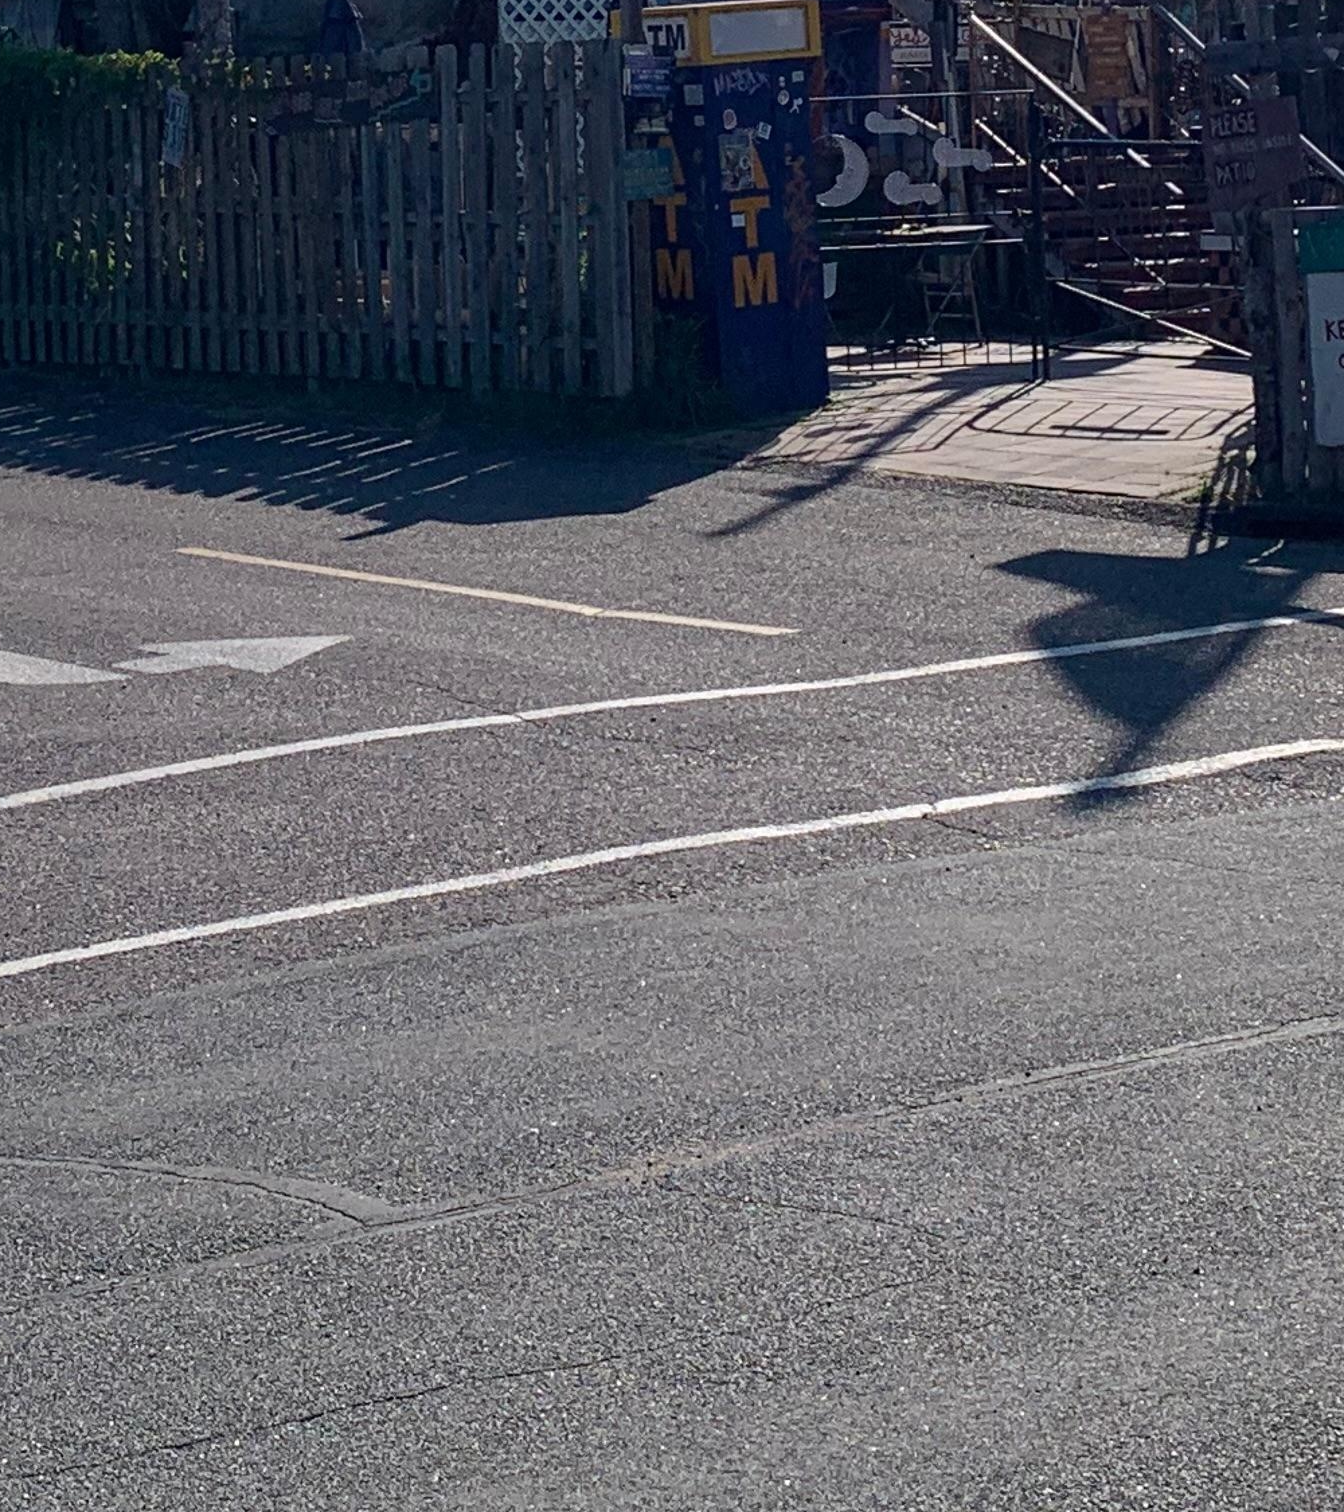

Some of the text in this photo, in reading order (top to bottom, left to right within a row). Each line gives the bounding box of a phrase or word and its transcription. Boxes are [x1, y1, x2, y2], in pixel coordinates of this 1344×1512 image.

[647, 24, 686, 51] TM
[1209, 111, 1257, 137] PLEASE
[1215, 161, 1256, 185] PATIO
